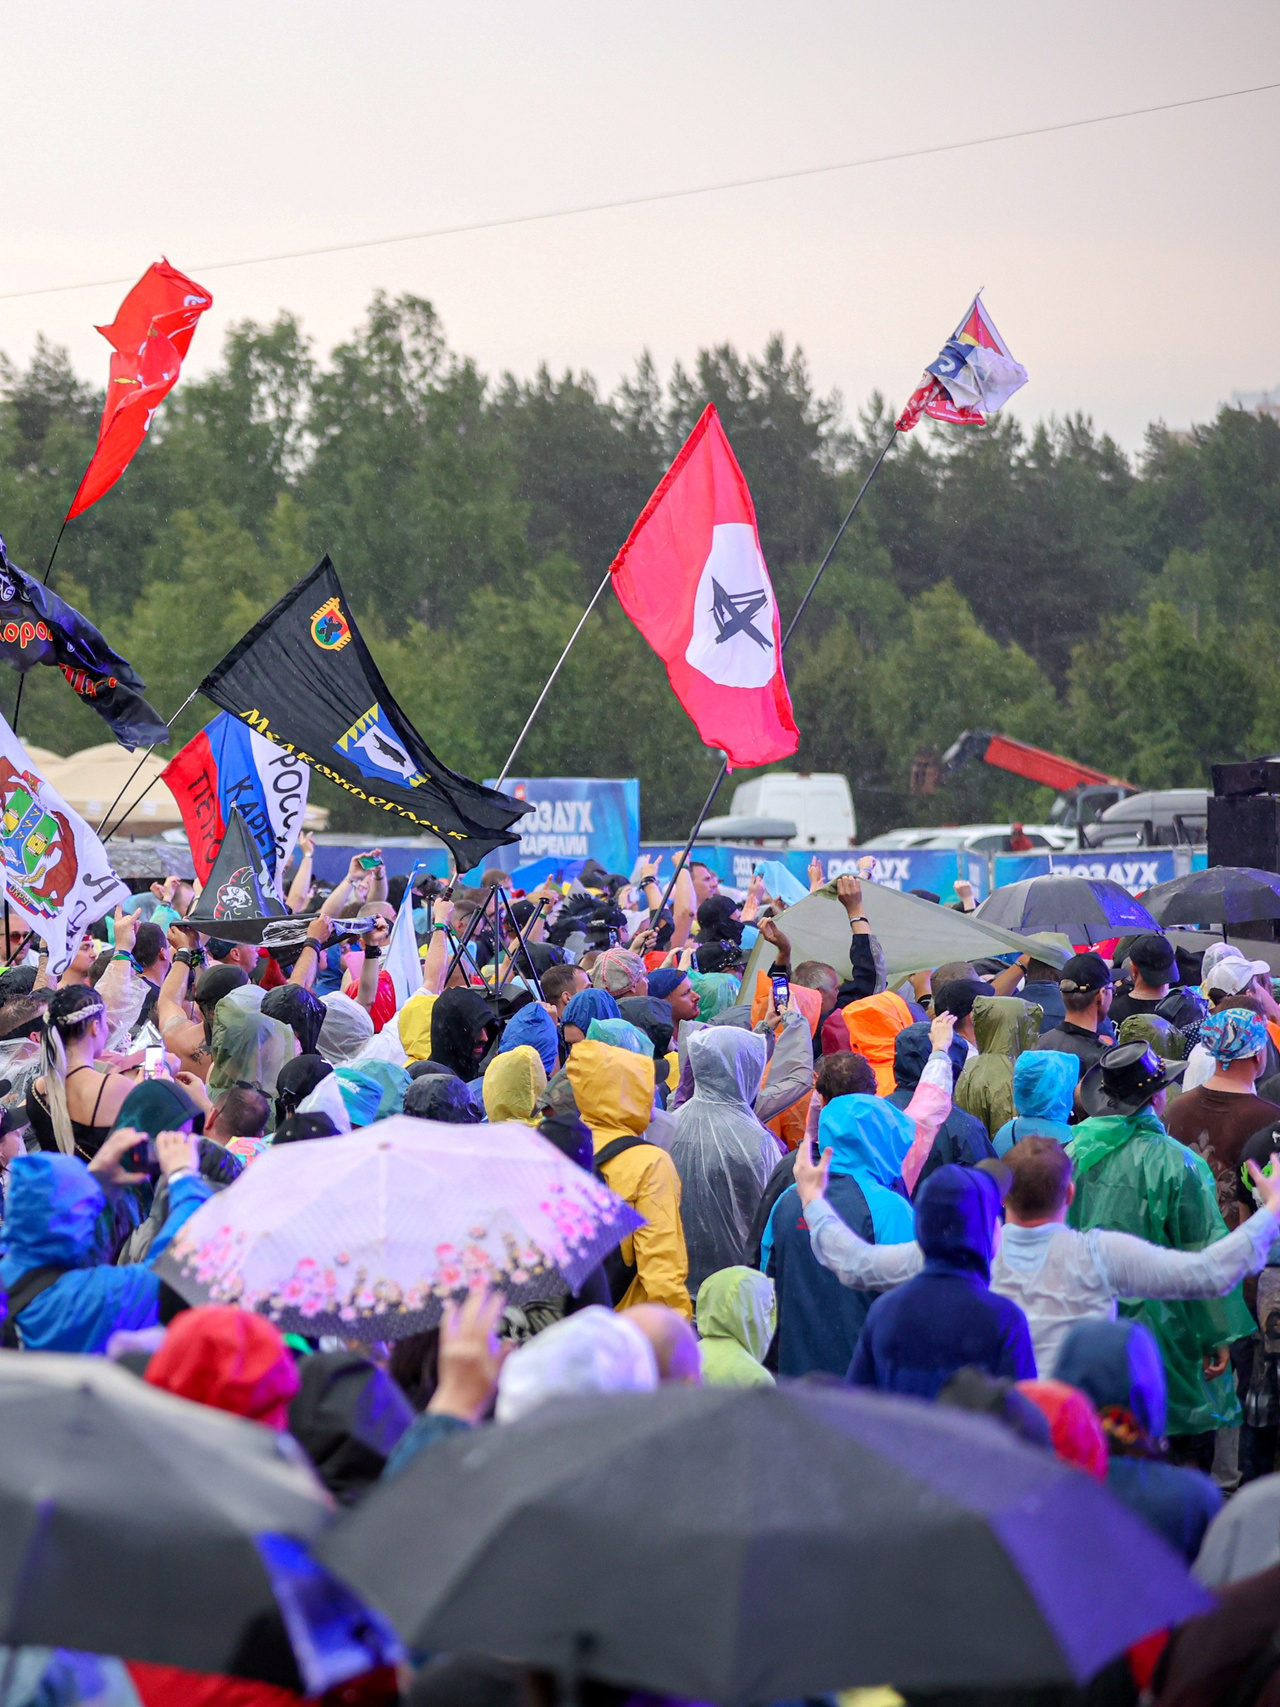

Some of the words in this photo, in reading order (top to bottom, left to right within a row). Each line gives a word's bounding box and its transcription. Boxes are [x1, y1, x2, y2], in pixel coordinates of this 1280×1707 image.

[226, 774, 277, 878] КАРЕ
[519, 834, 588, 856] КАРЕЛИИ
[827, 859, 911, 880] ВОДУХ
